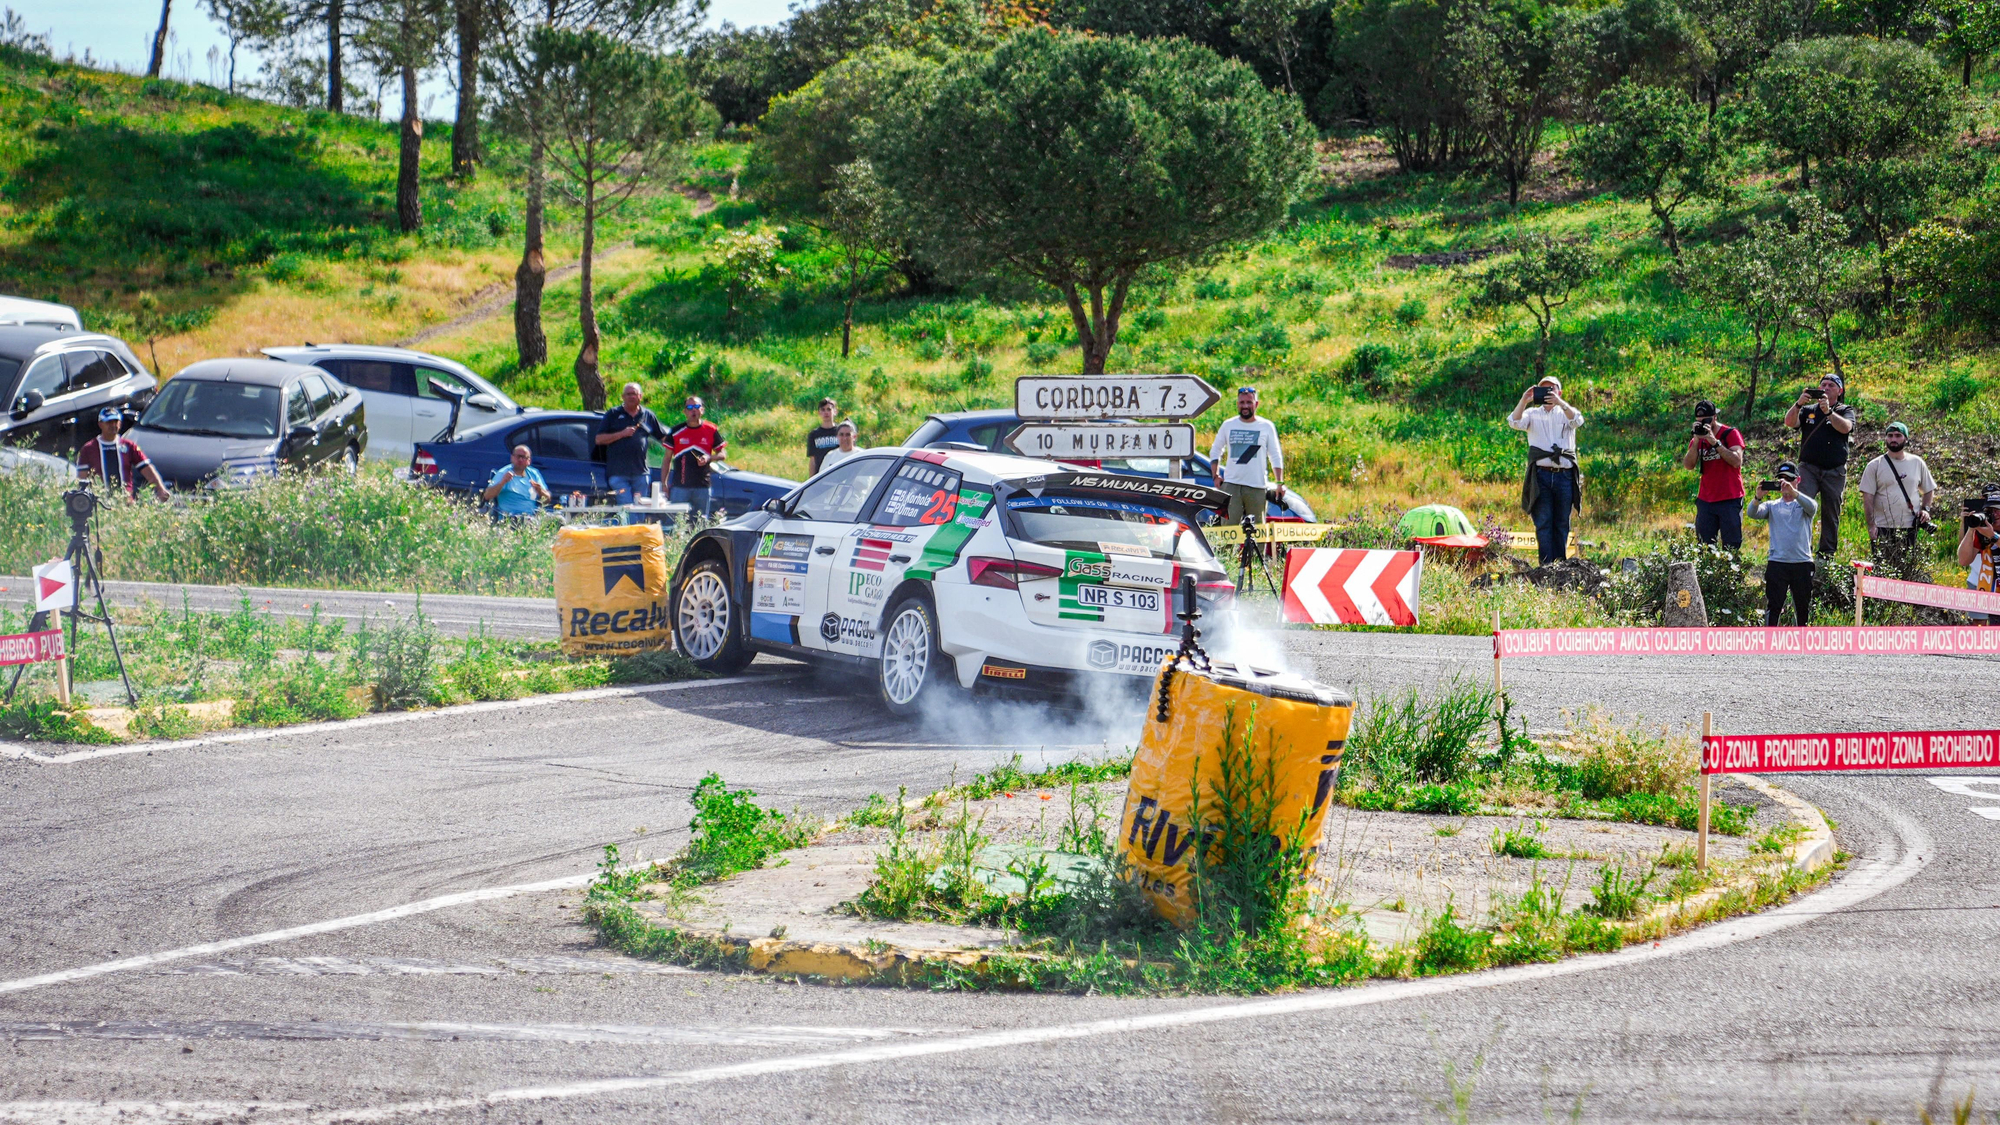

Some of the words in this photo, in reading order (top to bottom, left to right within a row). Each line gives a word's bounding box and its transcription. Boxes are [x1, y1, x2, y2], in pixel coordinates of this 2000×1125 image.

[1036, 385, 1140, 410] CORDOBA
[1036, 433, 1053, 449] 10
[1069, 475, 1099, 487] MS
[1098, 478, 1207, 500] MUNARETTO
[919, 489, 960, 525] 25
[1051, 498, 1083, 506] FOLLOW
[1277, 528, 1317, 537] PUBLICO
[758, 534, 774, 556] 25
[865, 573, 882, 586] ECO
[1069, 558, 1112, 578] Gass
[1112, 572, 1164, 585] RACING
[847, 571, 865, 596] IP
[1084, 588, 1108, 604] NR
[1113, 591, 1123, 605] S
[1129, 593, 1156, 609] 103
[984, 665, 1025, 678] PIRELLI
[1725, 739, 1759, 768] ZONA
[1764, 738, 1829, 768] PROHIBIDO
[1835, 736, 1886, 766] PUBLICO
[1891, 736, 1925, 765] ZONA
[1929, 735, 1993, 764] PROHIBIDO
